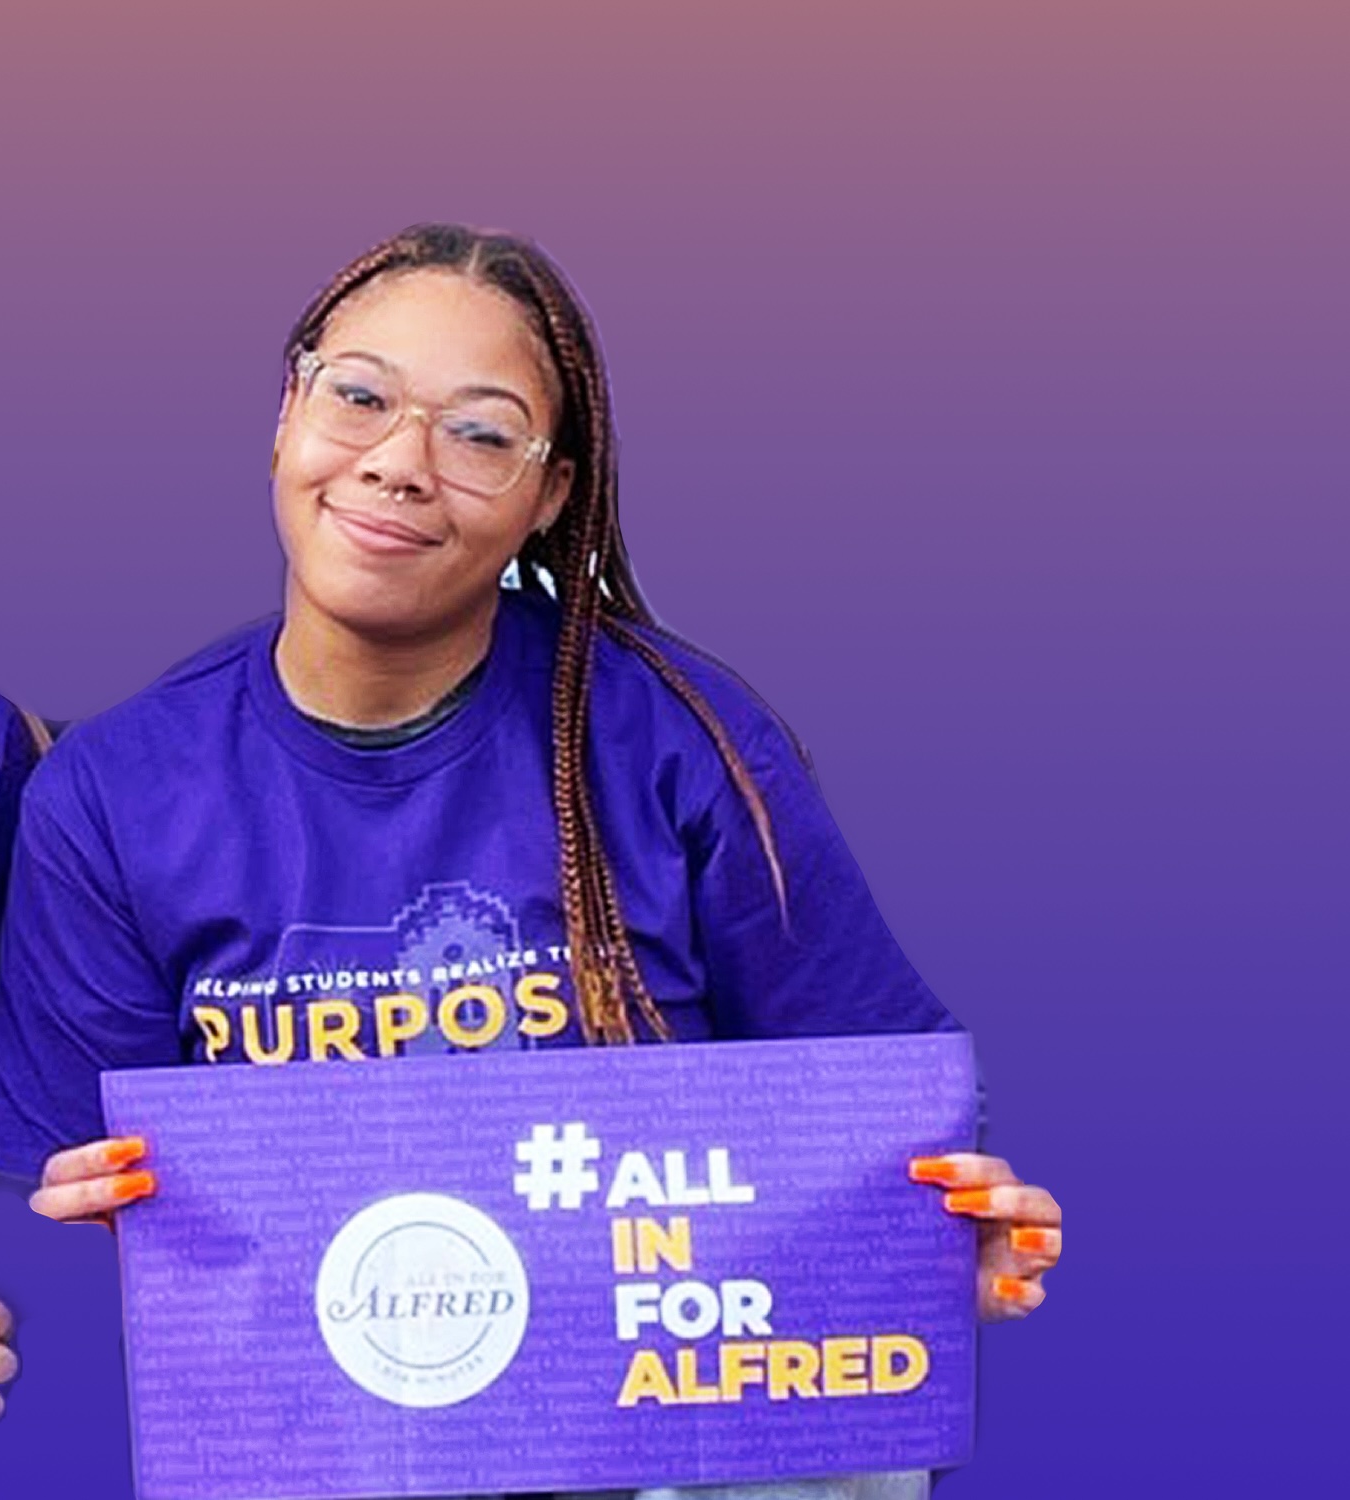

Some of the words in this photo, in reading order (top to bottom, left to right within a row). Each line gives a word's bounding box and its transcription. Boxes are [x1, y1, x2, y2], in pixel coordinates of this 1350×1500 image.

[286, 969, 421, 993] STUDENTS
[431, 950, 538, 982] REALIZE
[192, 973, 568, 1066] PURPOS
[513, 1122, 756, 1209] #ALL
[611, 1216, 692, 1275] IN
[326, 1284, 516, 1323] ALFRED
[614, 1279, 773, 1341] FOR
[617, 1334, 930, 1408] ALFRED
